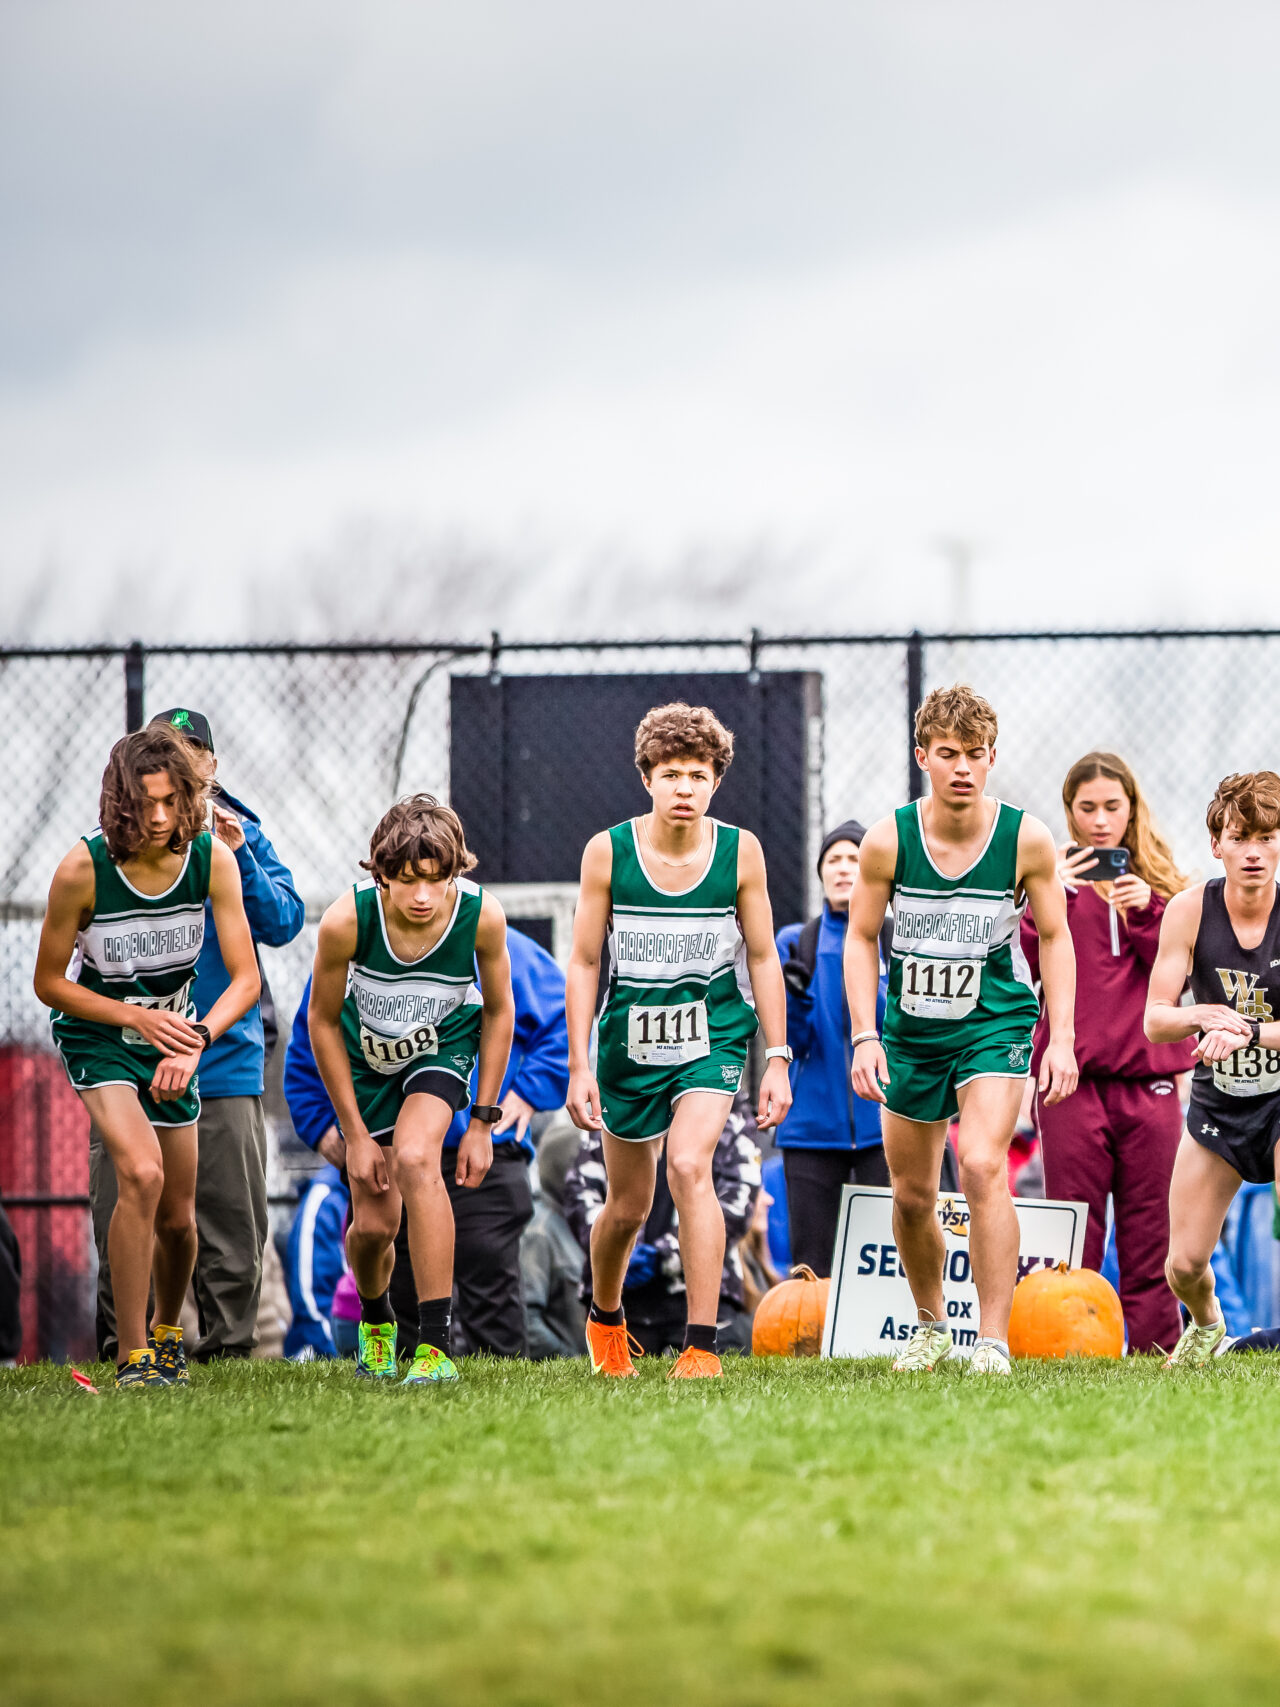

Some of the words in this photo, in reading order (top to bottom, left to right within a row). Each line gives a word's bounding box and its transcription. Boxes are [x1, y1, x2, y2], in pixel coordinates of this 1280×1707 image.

[907, 961, 975, 998] 1112
[636, 1006, 701, 1044] 1111
[363, 1027, 434, 1062] 1108
[938, 1211, 970, 1226] YSP
[944, 1297, 973, 1319] ox
